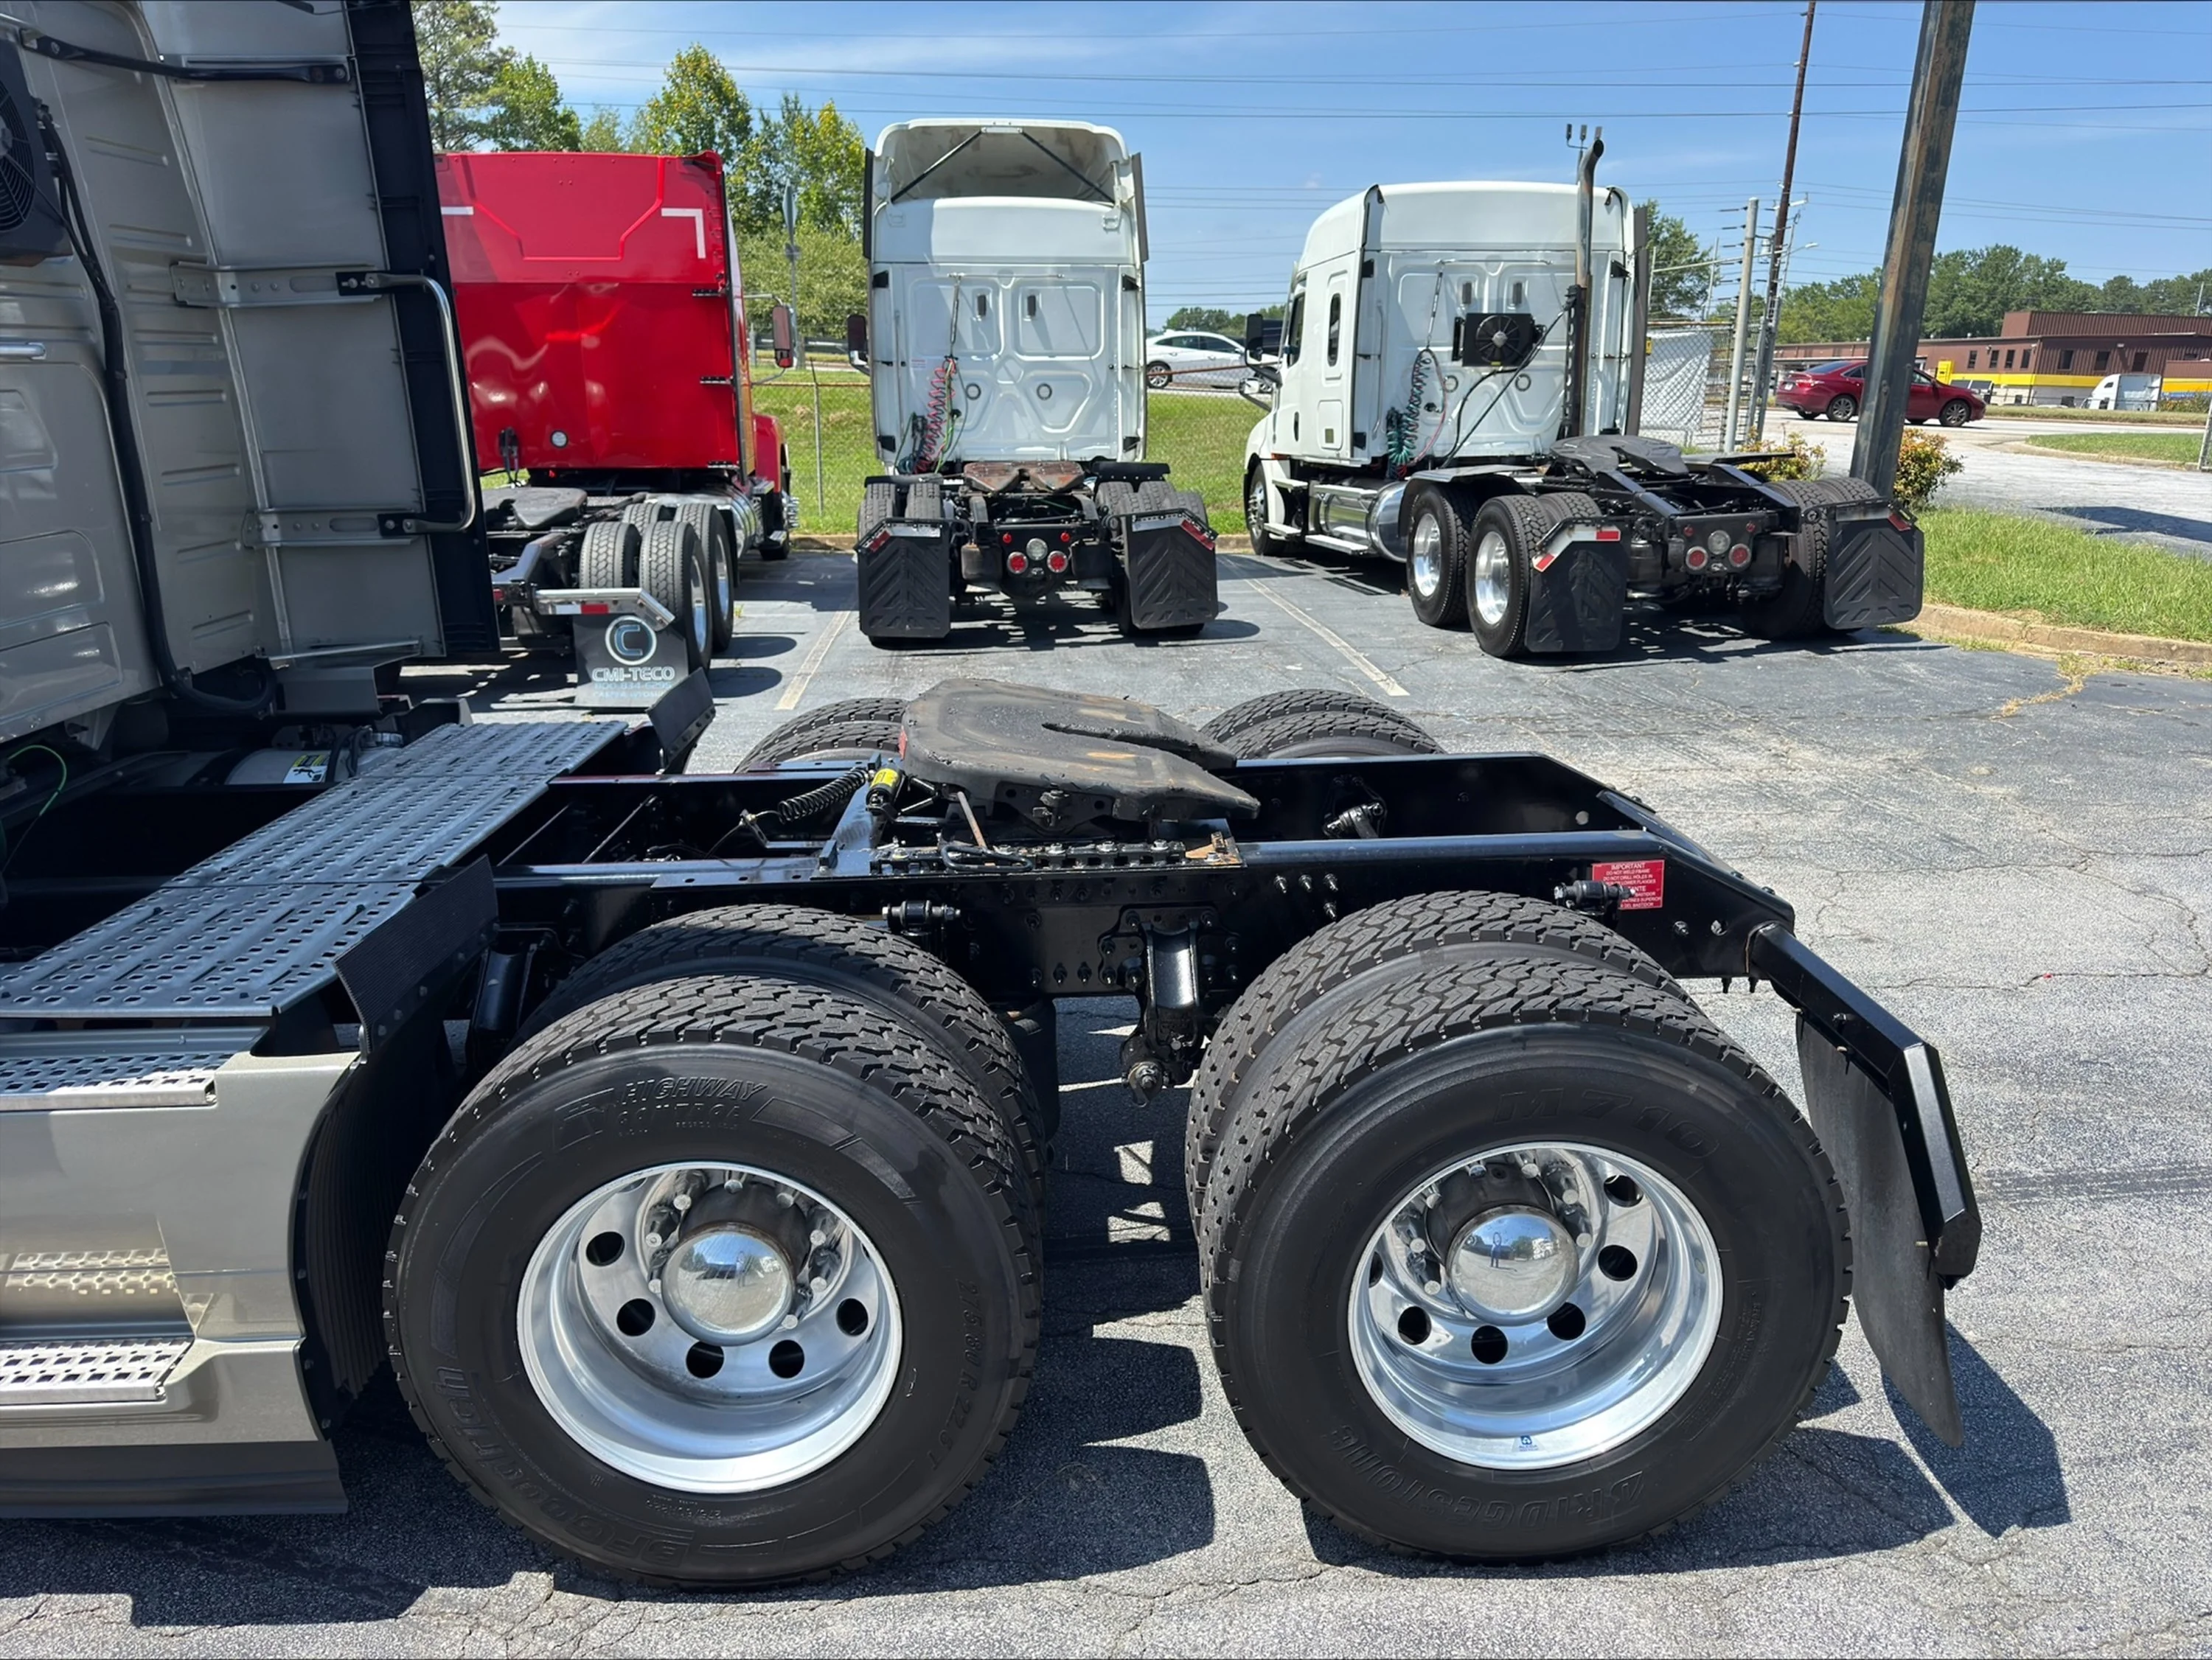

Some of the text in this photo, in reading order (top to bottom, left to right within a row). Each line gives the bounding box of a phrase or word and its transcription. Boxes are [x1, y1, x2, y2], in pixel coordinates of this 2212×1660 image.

[592, 666, 675, 682] CMI-TECO
[617, 1076, 768, 1106] HIGHWAY
[431, 1366, 691, 1568] BFGoodrich
[1320, 1423, 1645, 1532] BRIDGESTONE
